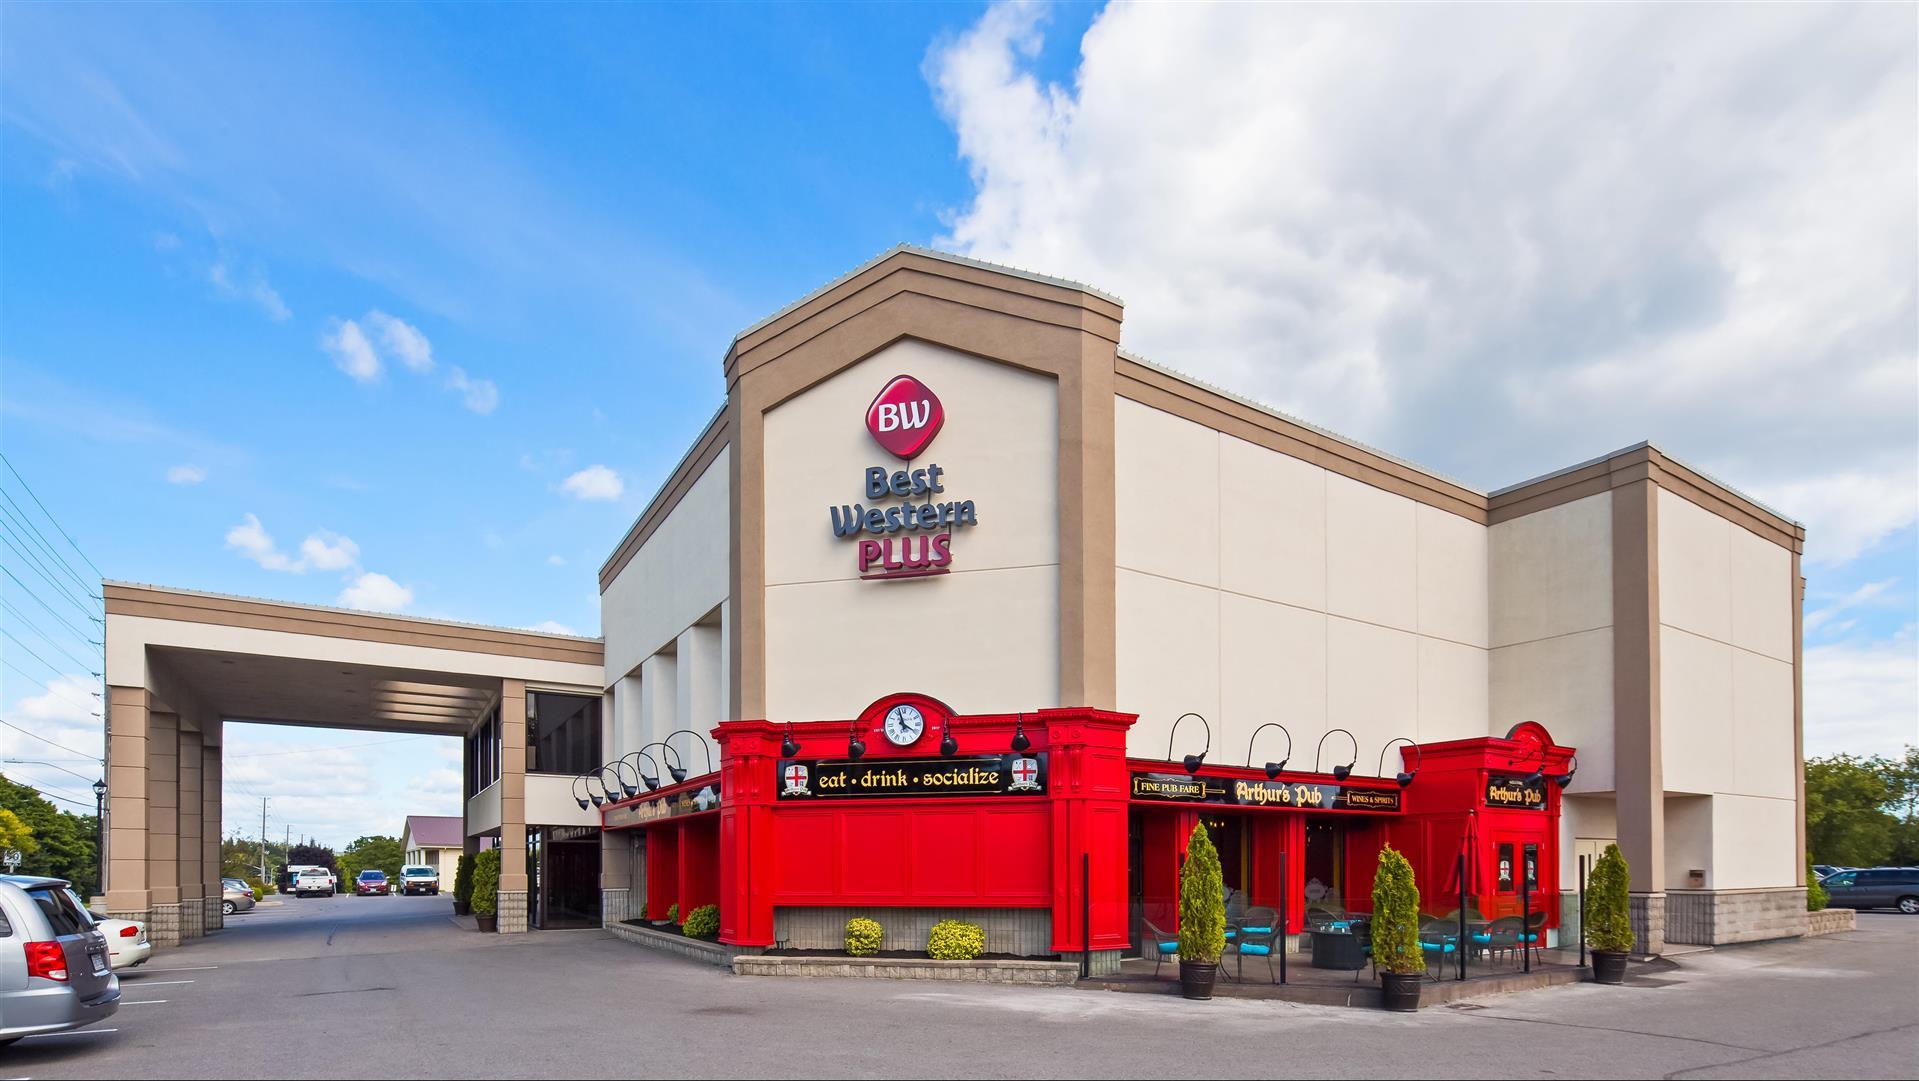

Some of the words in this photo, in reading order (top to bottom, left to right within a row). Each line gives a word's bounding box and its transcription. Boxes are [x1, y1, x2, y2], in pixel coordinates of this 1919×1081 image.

[878, 399, 931, 432] BW
[865, 463, 945, 500] Best
[830, 499, 978, 538] Western
[858, 533, 953, 573] PLUS
[819, 771, 847, 788] eat
[861, 769, 908, 787] drink
[923, 766, 999, 786] socialize
[1141, 782, 1160, 791] FINE
[1161, 783, 1178, 793] PUB
[1180, 785, 1200, 794] FARE
[1236, 781, 1291, 805] Arthur's
[1295, 785, 1322, 807] Pub
[1351, 795, 1369, 803] WINES
[1490, 785, 1522, 804] Arthur's
[1524, 788, 1542, 806] Pub
